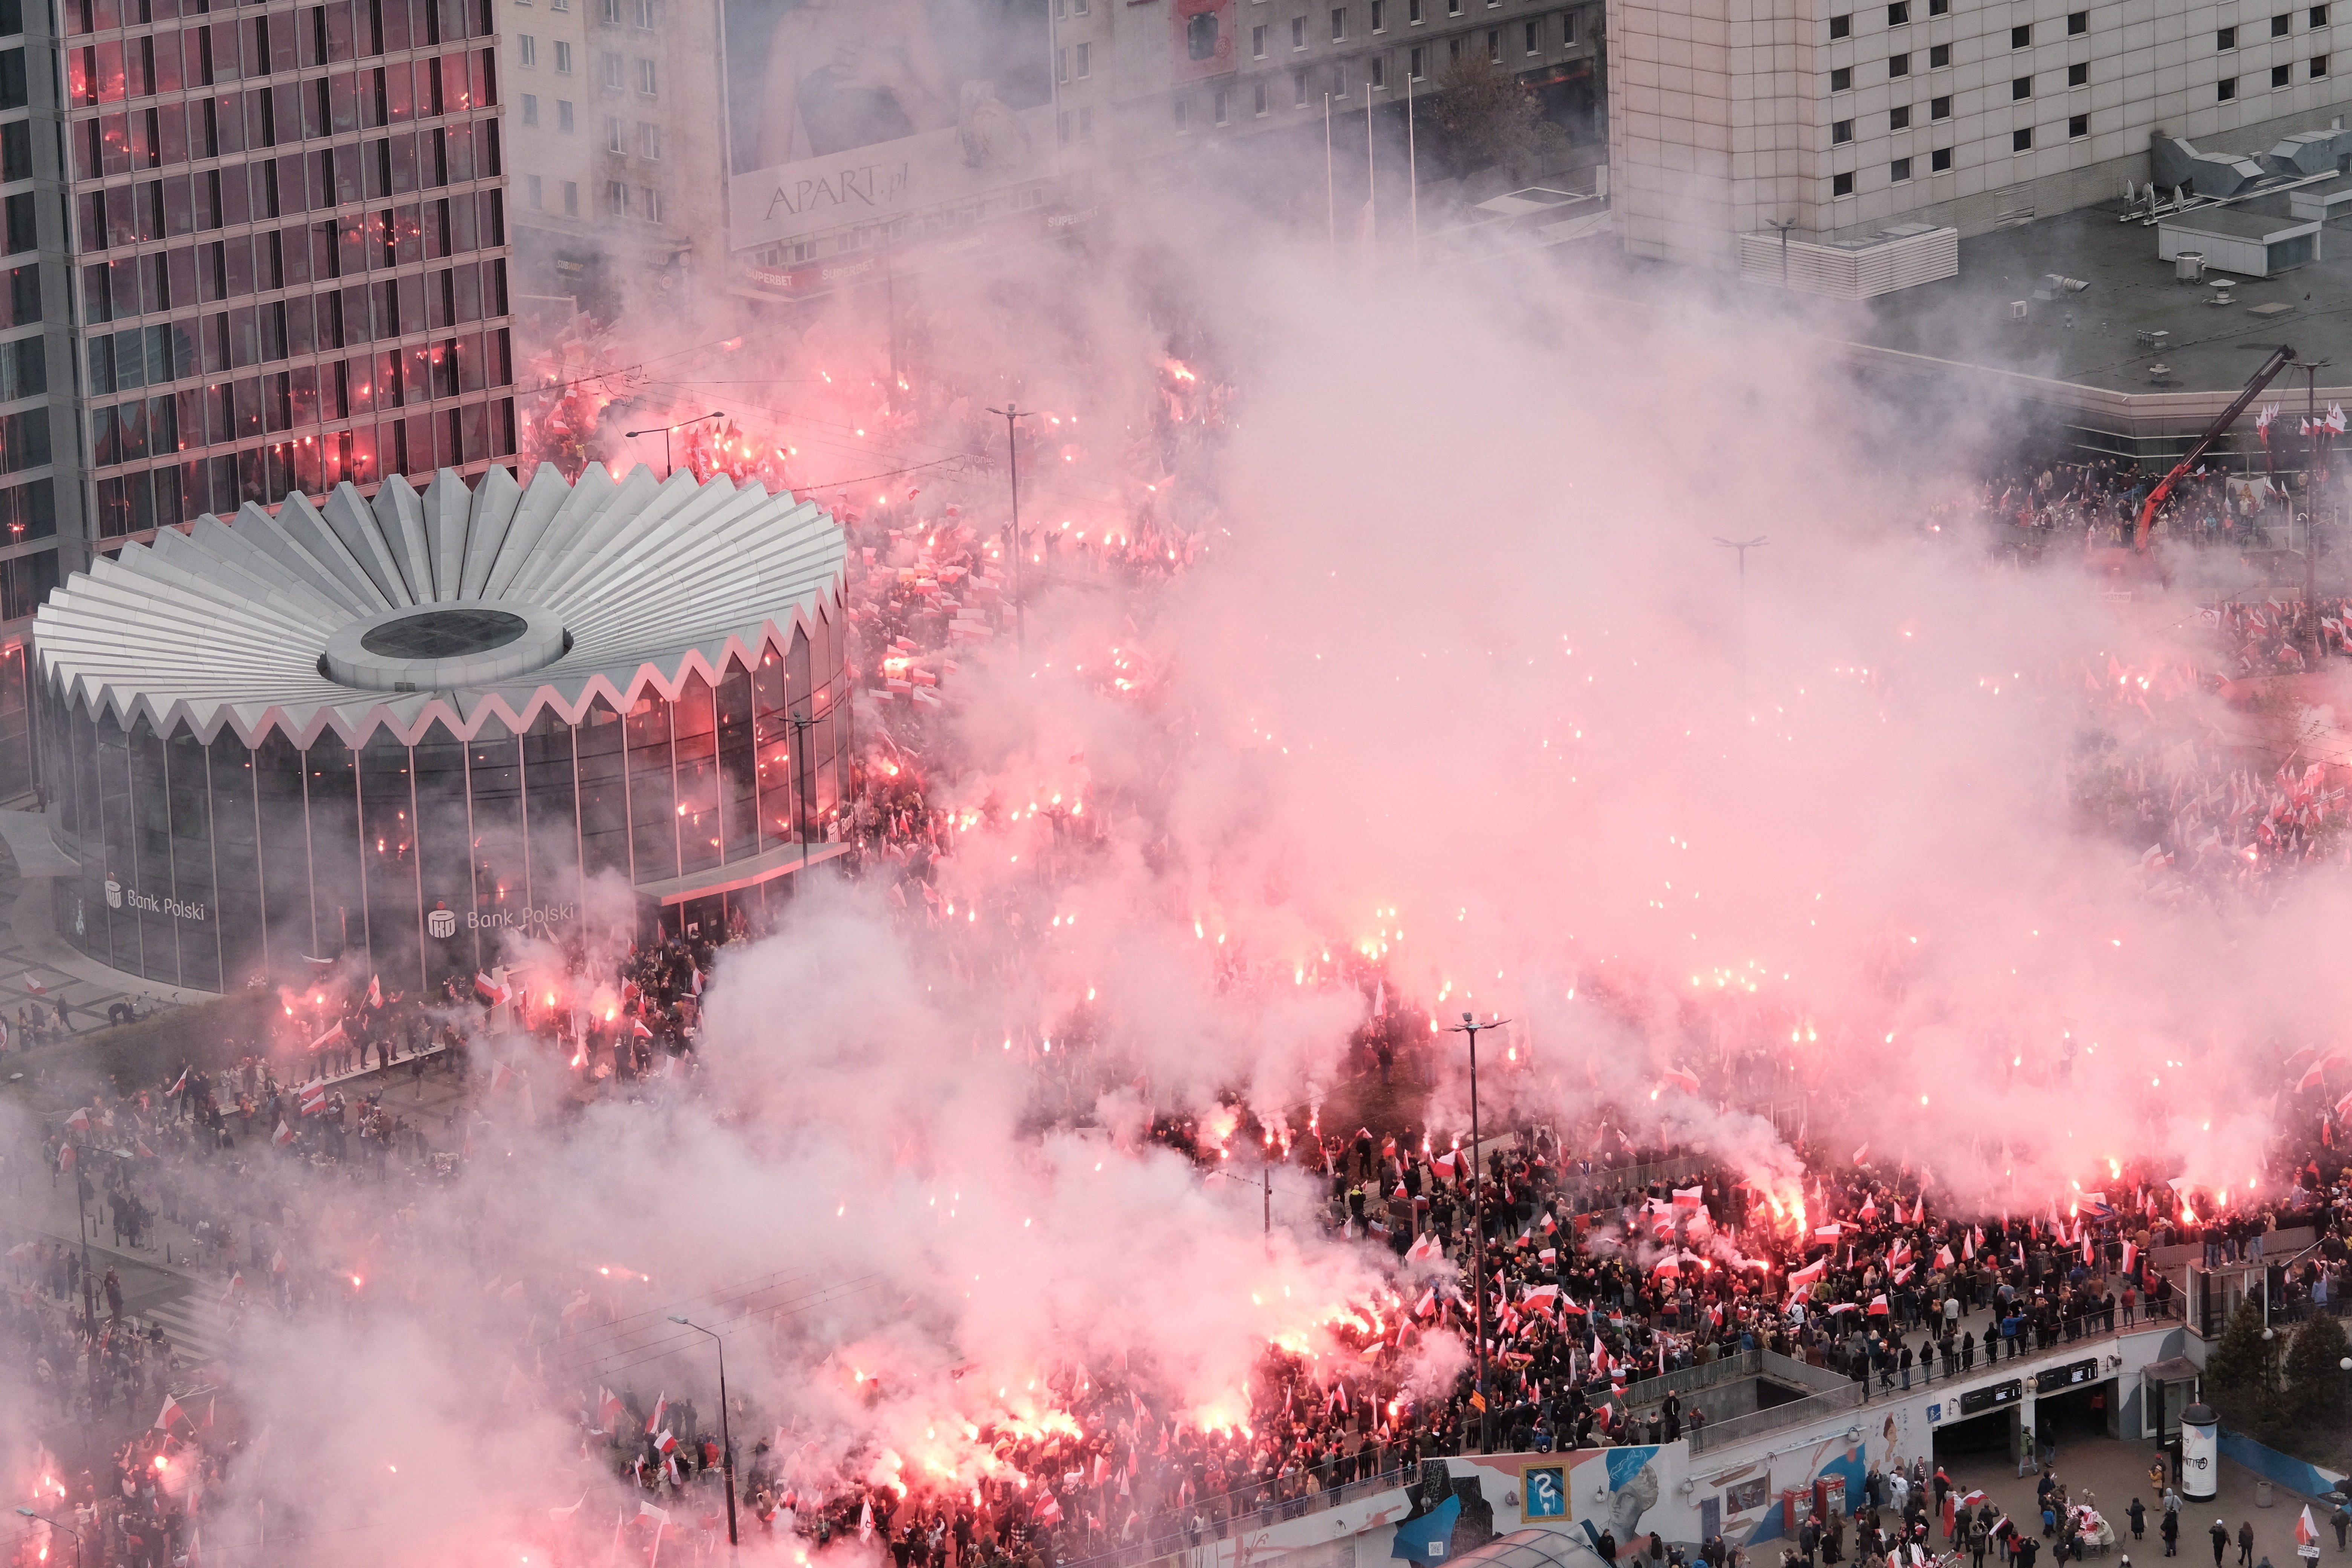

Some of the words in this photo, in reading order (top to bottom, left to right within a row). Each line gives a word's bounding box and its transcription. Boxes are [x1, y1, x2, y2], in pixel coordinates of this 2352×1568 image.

[936, 233, 987, 255] SUPERBET
[745, 266, 793, 286] SUPERBET
[822, 259, 876, 281] SUPERBET
[127, 889, 159, 912] Bank
[165, 897, 205, 921] Polski
[467, 908, 513, 929] Bank
[522, 902, 575, 924] Polski
